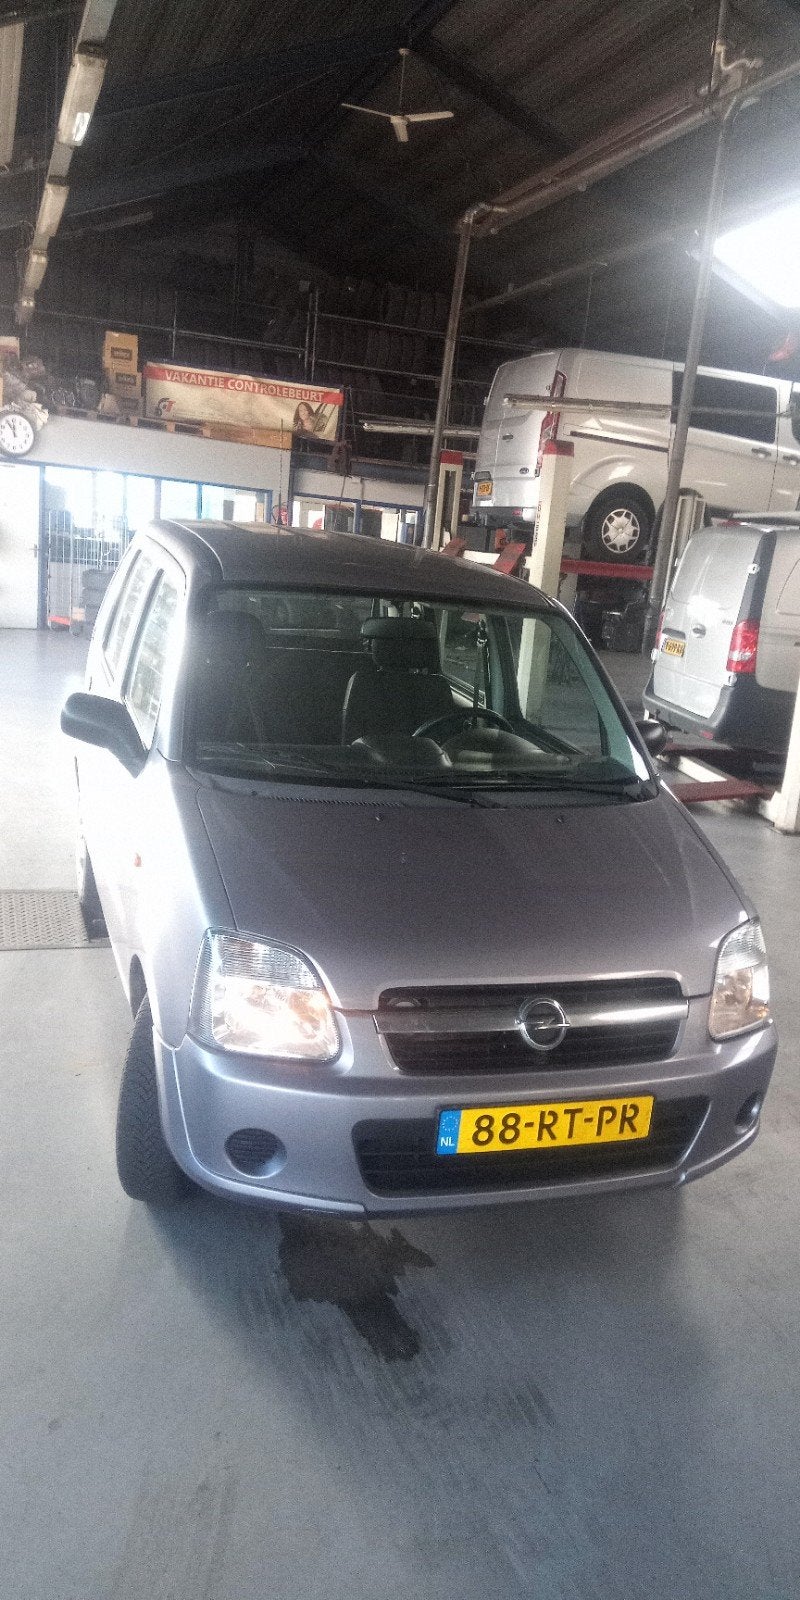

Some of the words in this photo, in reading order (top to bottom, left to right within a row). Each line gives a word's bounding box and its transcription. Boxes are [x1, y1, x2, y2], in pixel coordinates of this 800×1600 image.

[164, 369, 225, 388] VAKANTIE
[227, 379, 325, 402] CONTROLEBEURT
[440, 1136, 455, 1147] NL
[471, 1103, 640, 1147] 88-RT-PR
